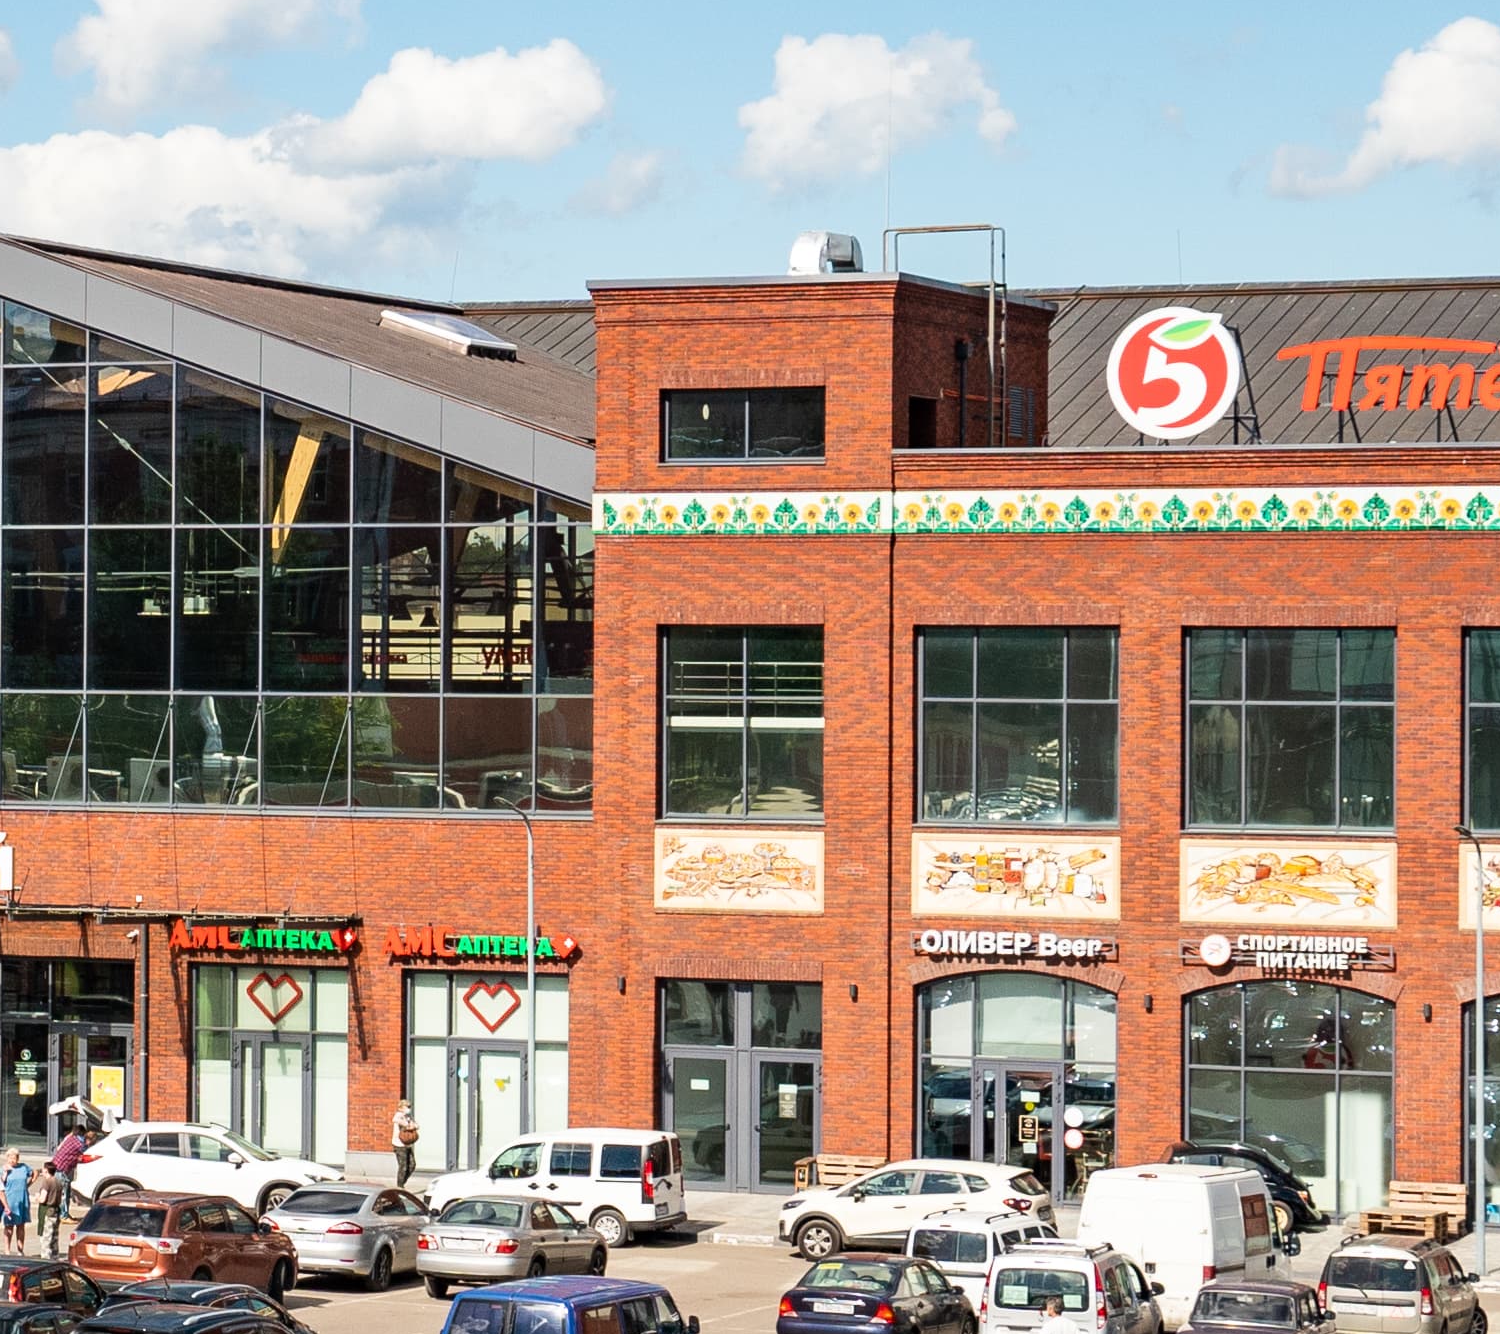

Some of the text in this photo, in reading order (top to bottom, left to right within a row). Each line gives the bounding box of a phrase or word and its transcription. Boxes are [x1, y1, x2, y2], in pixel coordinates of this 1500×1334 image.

[240, 928, 334, 951] АПТЕКА
[921, 929, 1102, 957] ОЛИВЕР Beer
[1237, 935, 1367, 954] СПОРТИВНОЕ
[1255, 952, 1349, 970] ПИТАНИЕ
